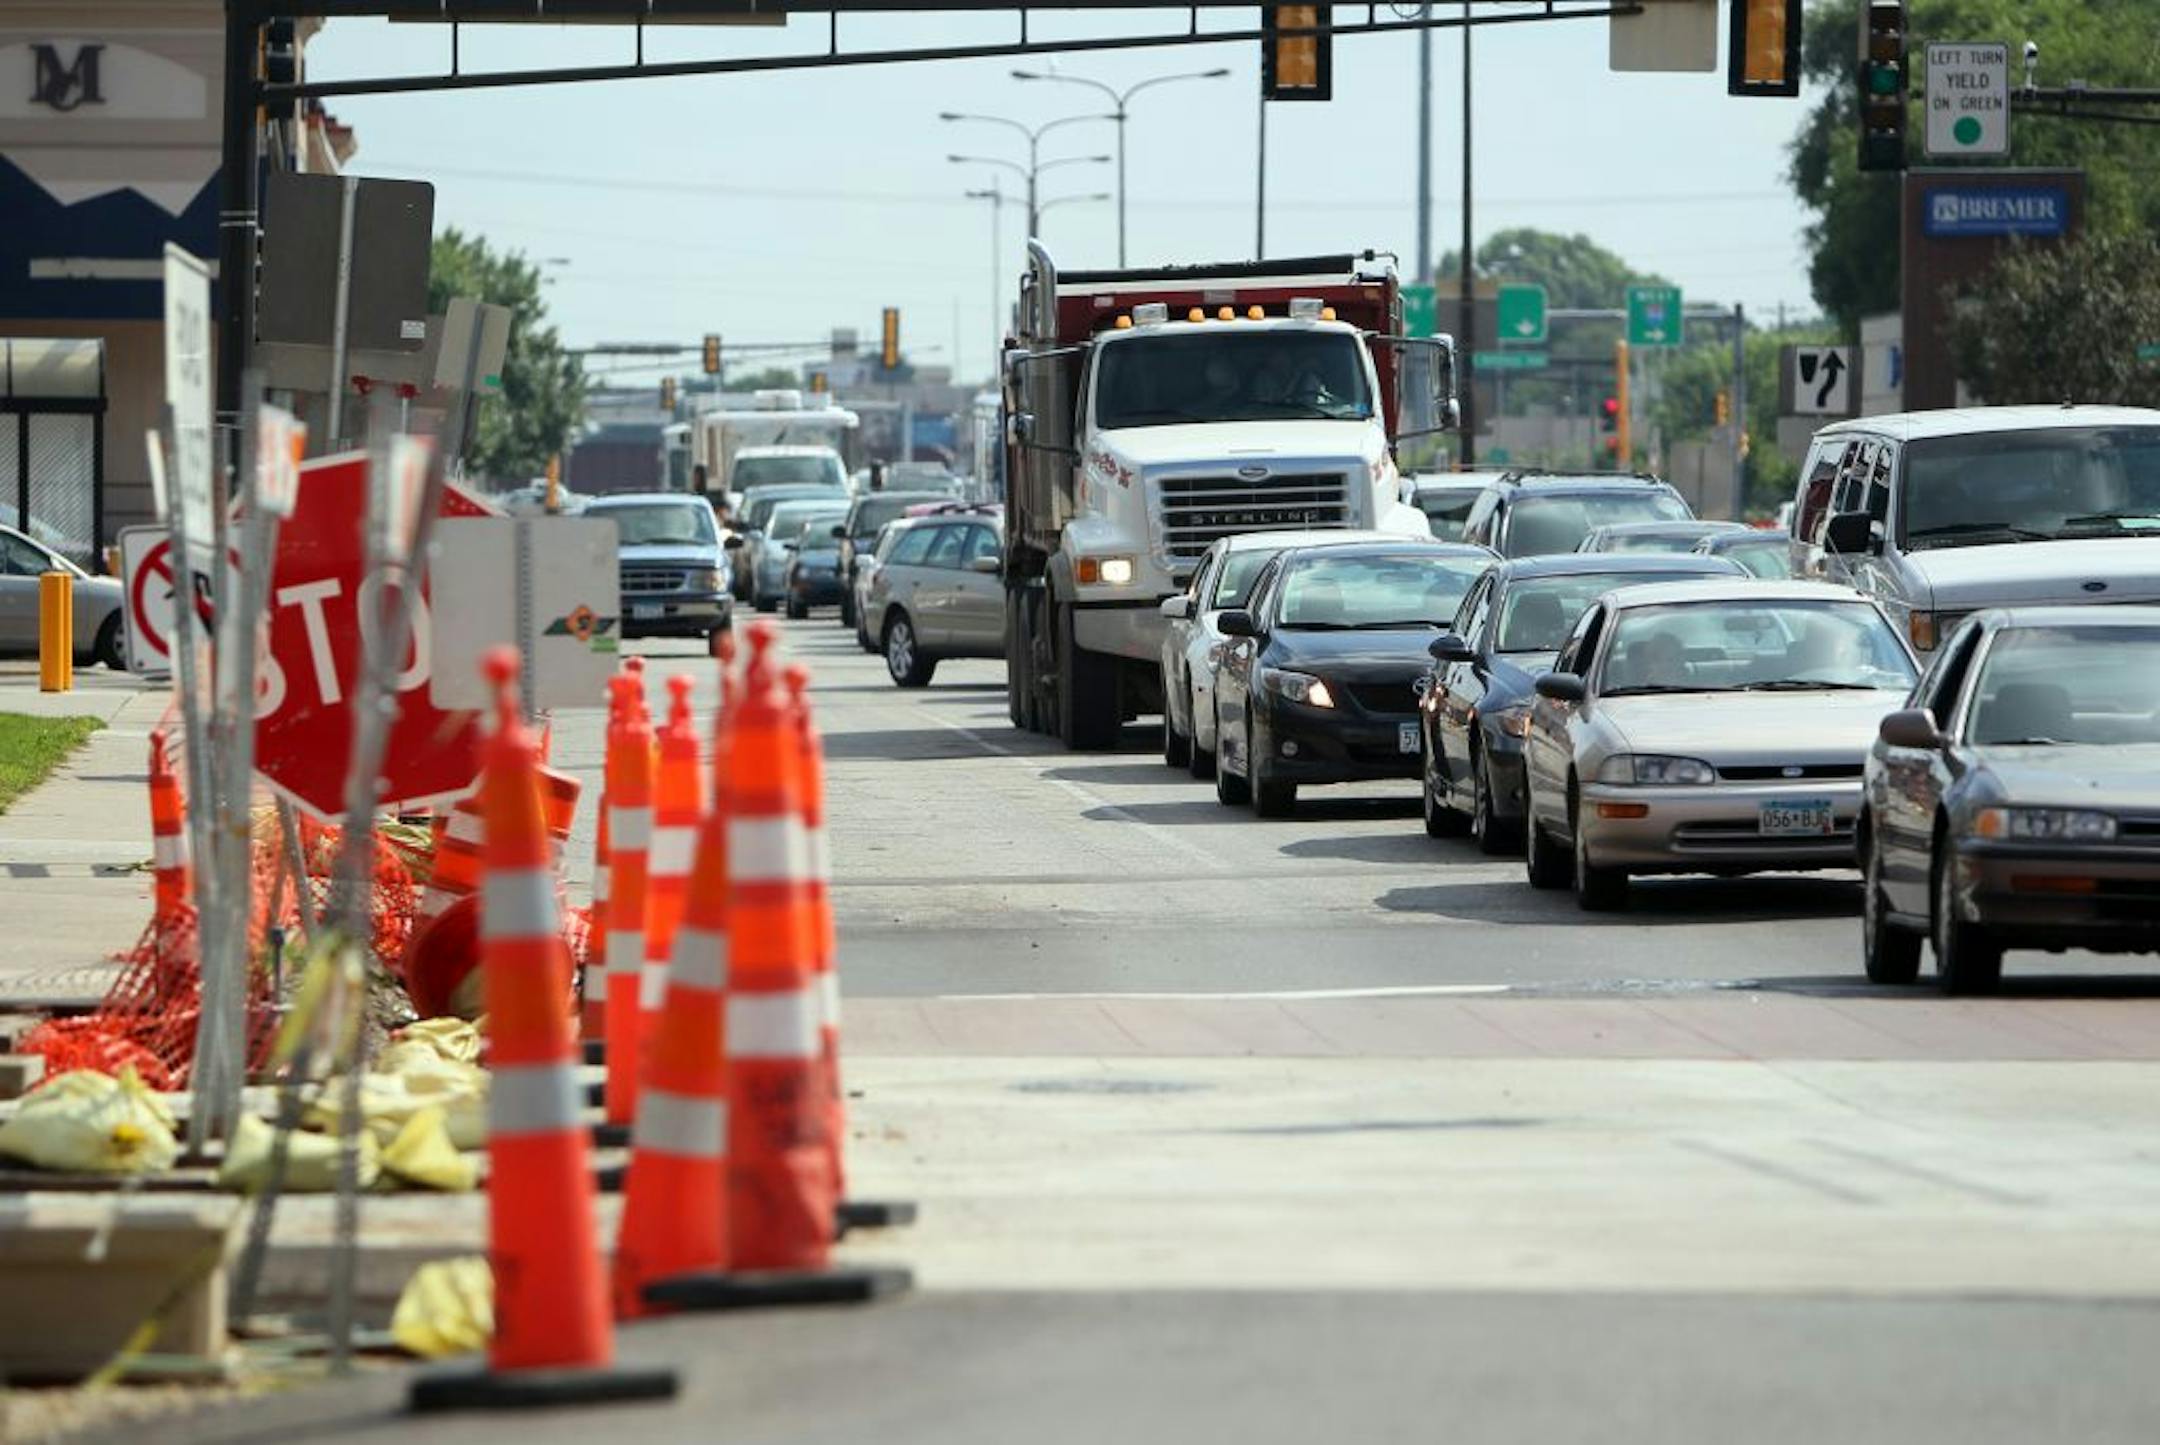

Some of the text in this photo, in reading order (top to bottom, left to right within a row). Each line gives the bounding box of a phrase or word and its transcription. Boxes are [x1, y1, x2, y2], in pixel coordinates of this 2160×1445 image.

[1931, 50, 2003, 65] LEFT TURN
[1946, 72, 1989, 88] YIELD
[1933, 96, 2003, 110] ON GREEN
[1960, 197, 2056, 219] BREMER
[1191, 510, 1319, 525] STERLING
